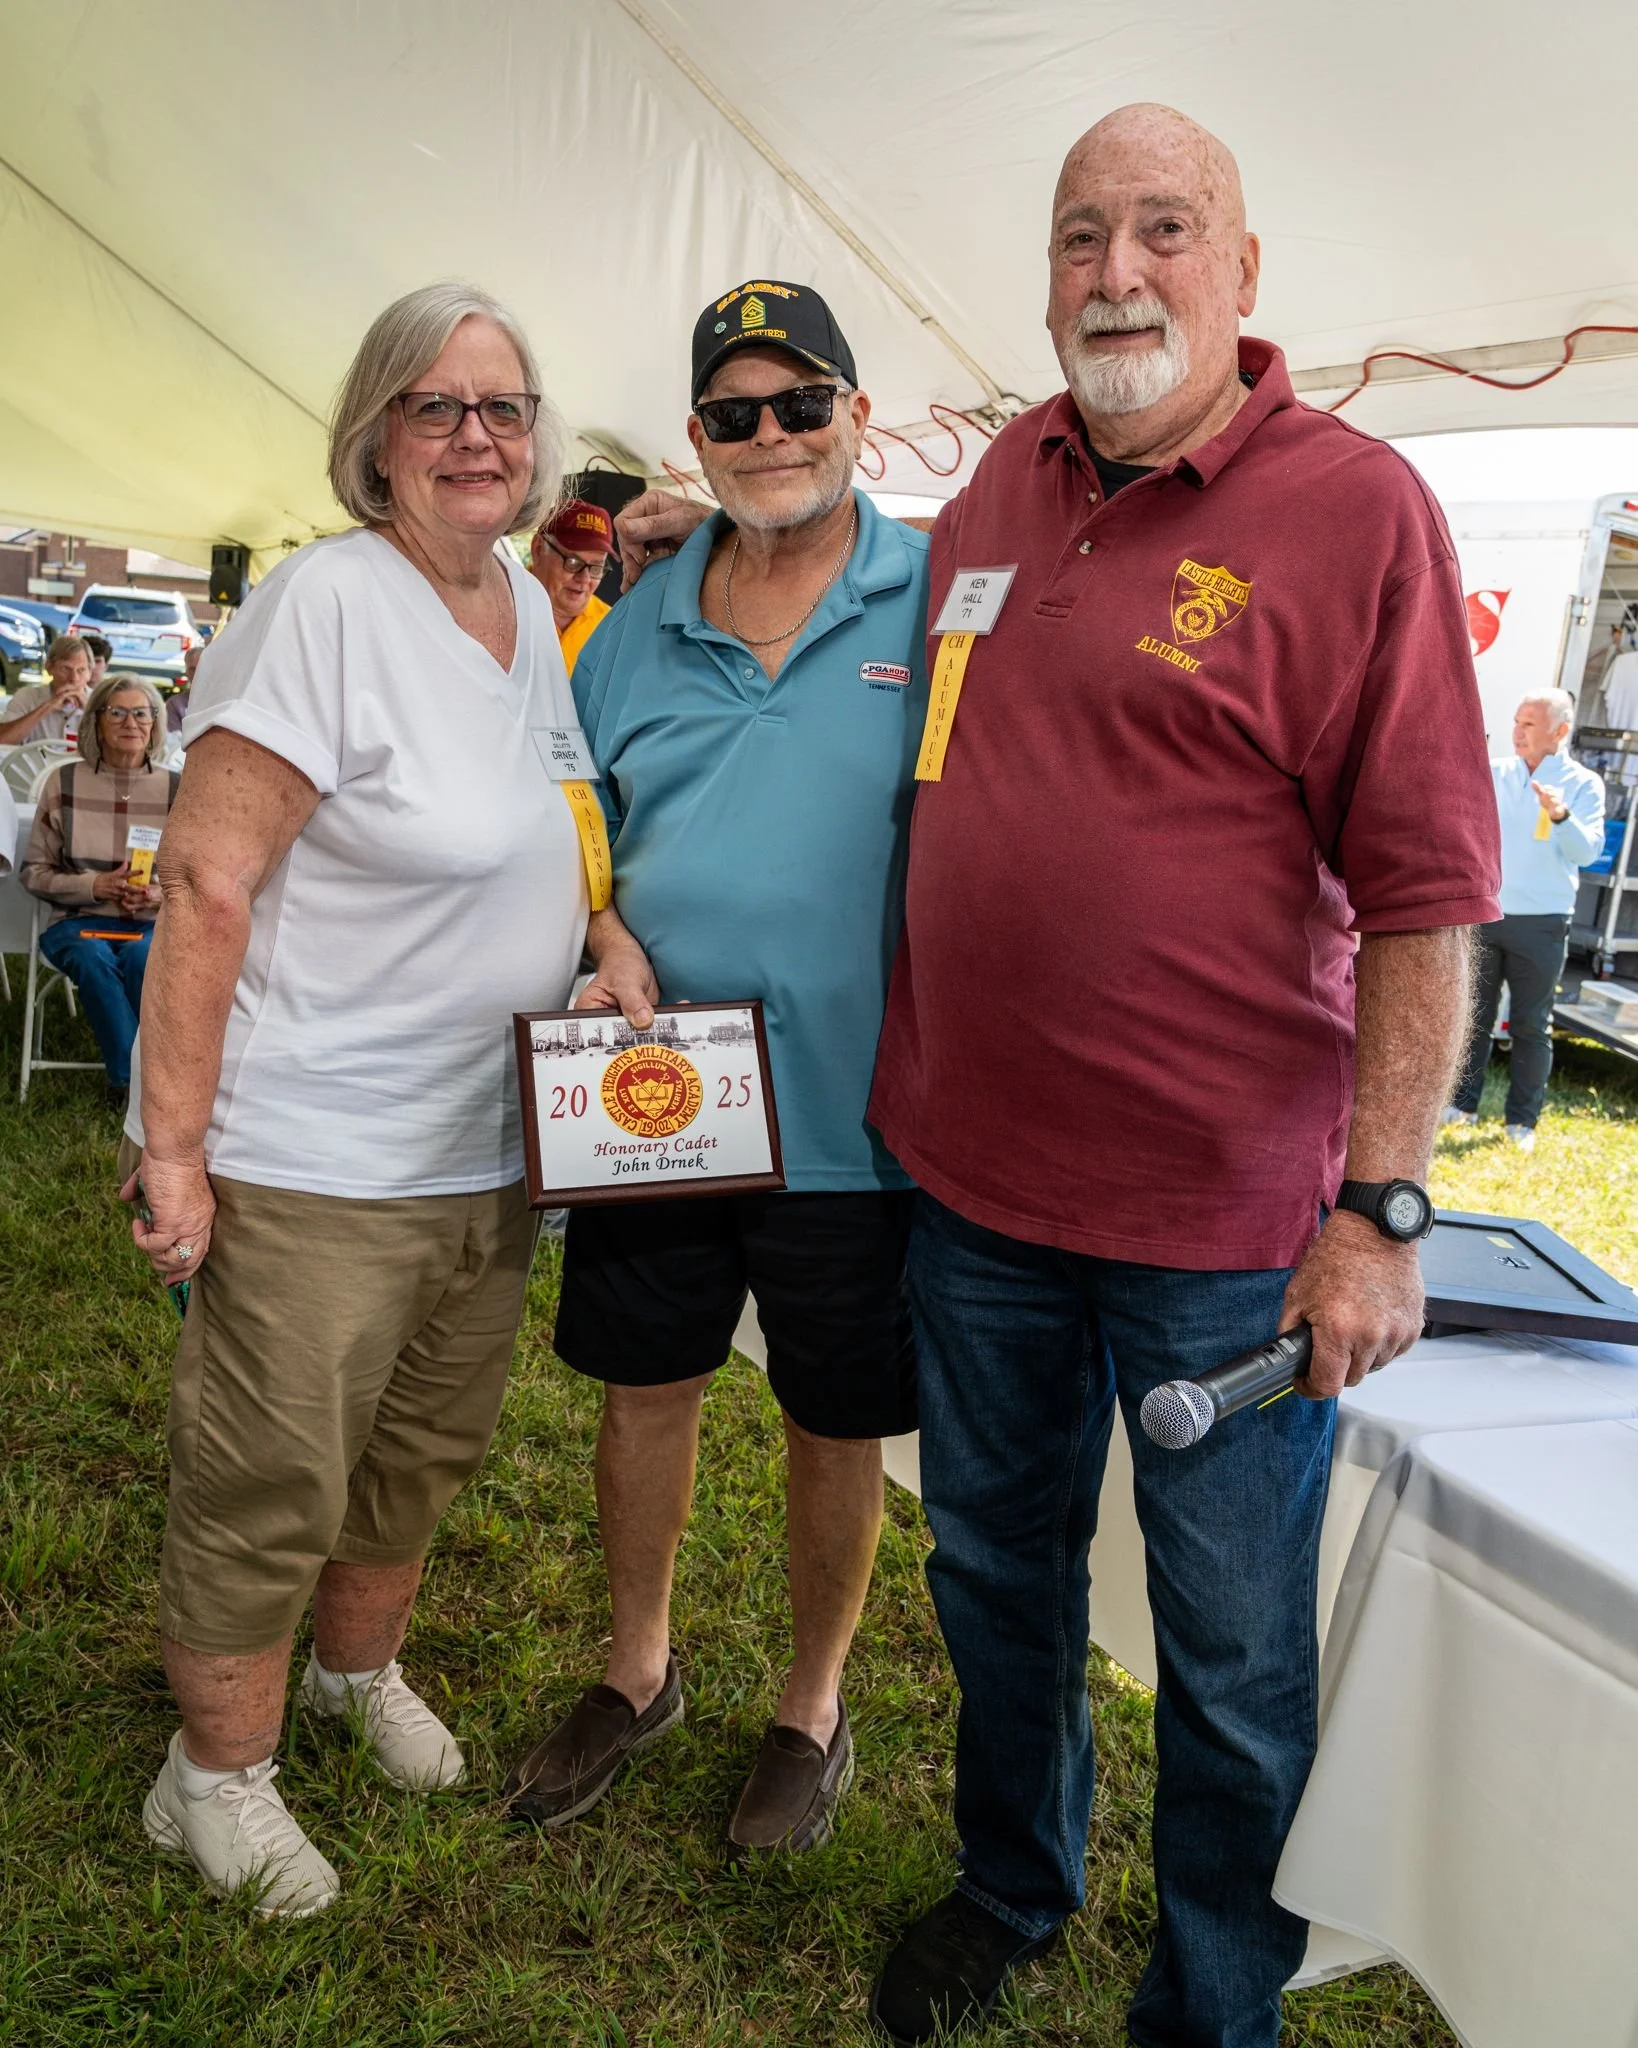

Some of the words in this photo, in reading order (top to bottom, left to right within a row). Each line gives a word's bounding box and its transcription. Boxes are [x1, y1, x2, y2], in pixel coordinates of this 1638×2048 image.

[741, 282, 792, 299] ARMY
[970, 578, 988, 589] KEN
[1181, 562, 1215, 586] CASTLE
[1212, 577, 1249, 602] HEIGHTS
[961, 593, 983, 604] HALL
[948, 635, 965, 649] CH
[1135, 636, 1203, 673] ALUMNI
[868, 683, 901, 693] TENNESSEE
[549, 731, 569, 741] TINA
[551, 750, 579, 760] DRNEK
[572, 789, 588, 800] CH
[630, 1061, 668, 1074] SIGILLUM
[634, 1047, 695, 1074] MILITARY
[602, 1052, 633, 1093] HEIGHTS
[619, 1088, 630, 1104] LUX
[669, 1079, 683, 1110] VERITAS
[717, 1073, 752, 1108] 25
[550, 1084, 587, 1119] 20
[627, 1103, 638, 1114] ET
[674, 1077, 701, 1128] ACADEMY
[603, 1095, 638, 1131] CASTLE
[594, 1141, 668, 1157] Honorary
[674, 1134, 718, 1152] Cadet
[612, 1157, 650, 1176] John
[655, 1152, 709, 1171] Drnek
